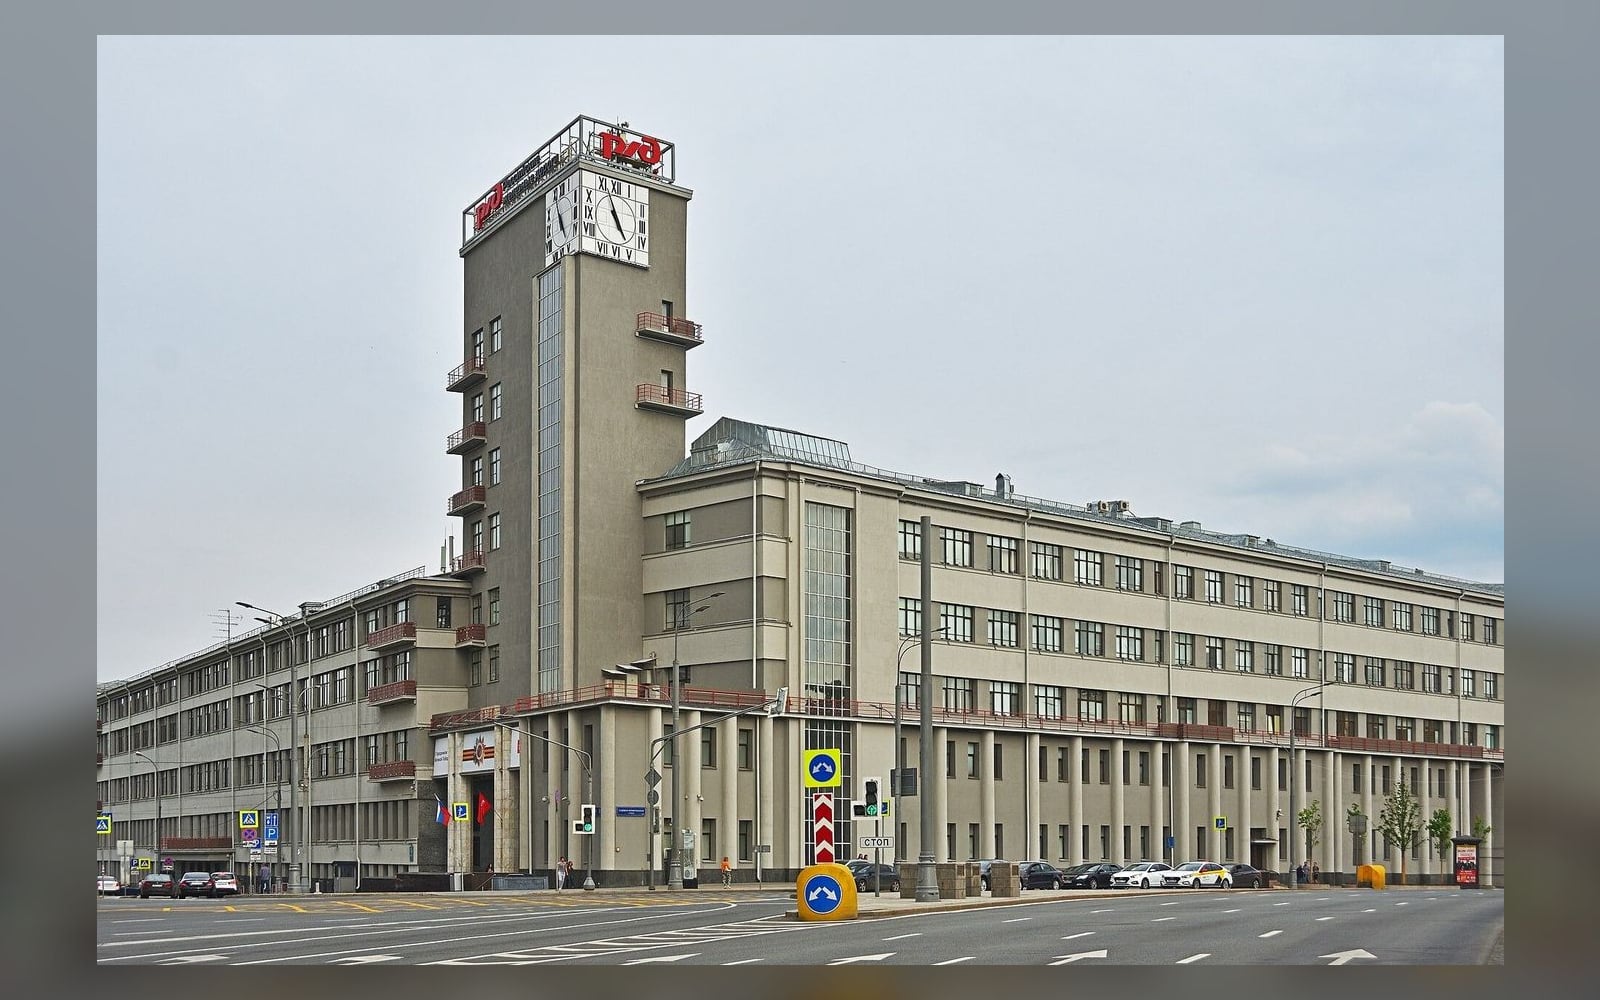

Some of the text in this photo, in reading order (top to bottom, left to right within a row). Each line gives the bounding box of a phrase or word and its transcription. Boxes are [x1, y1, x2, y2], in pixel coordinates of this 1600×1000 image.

[599, 176, 607, 191] XI
[611, 179, 622, 195] XII
[586, 189, 592, 203] X
[584, 205, 593, 220] IX
[583, 221, 595, 236] VIII
[597, 241, 608, 254] VII
[638, 236, 647, 250] IV
[612, 245, 620, 258] VI
[626, 249, 632, 260] V
[864, 838, 889, 846] СТОП
